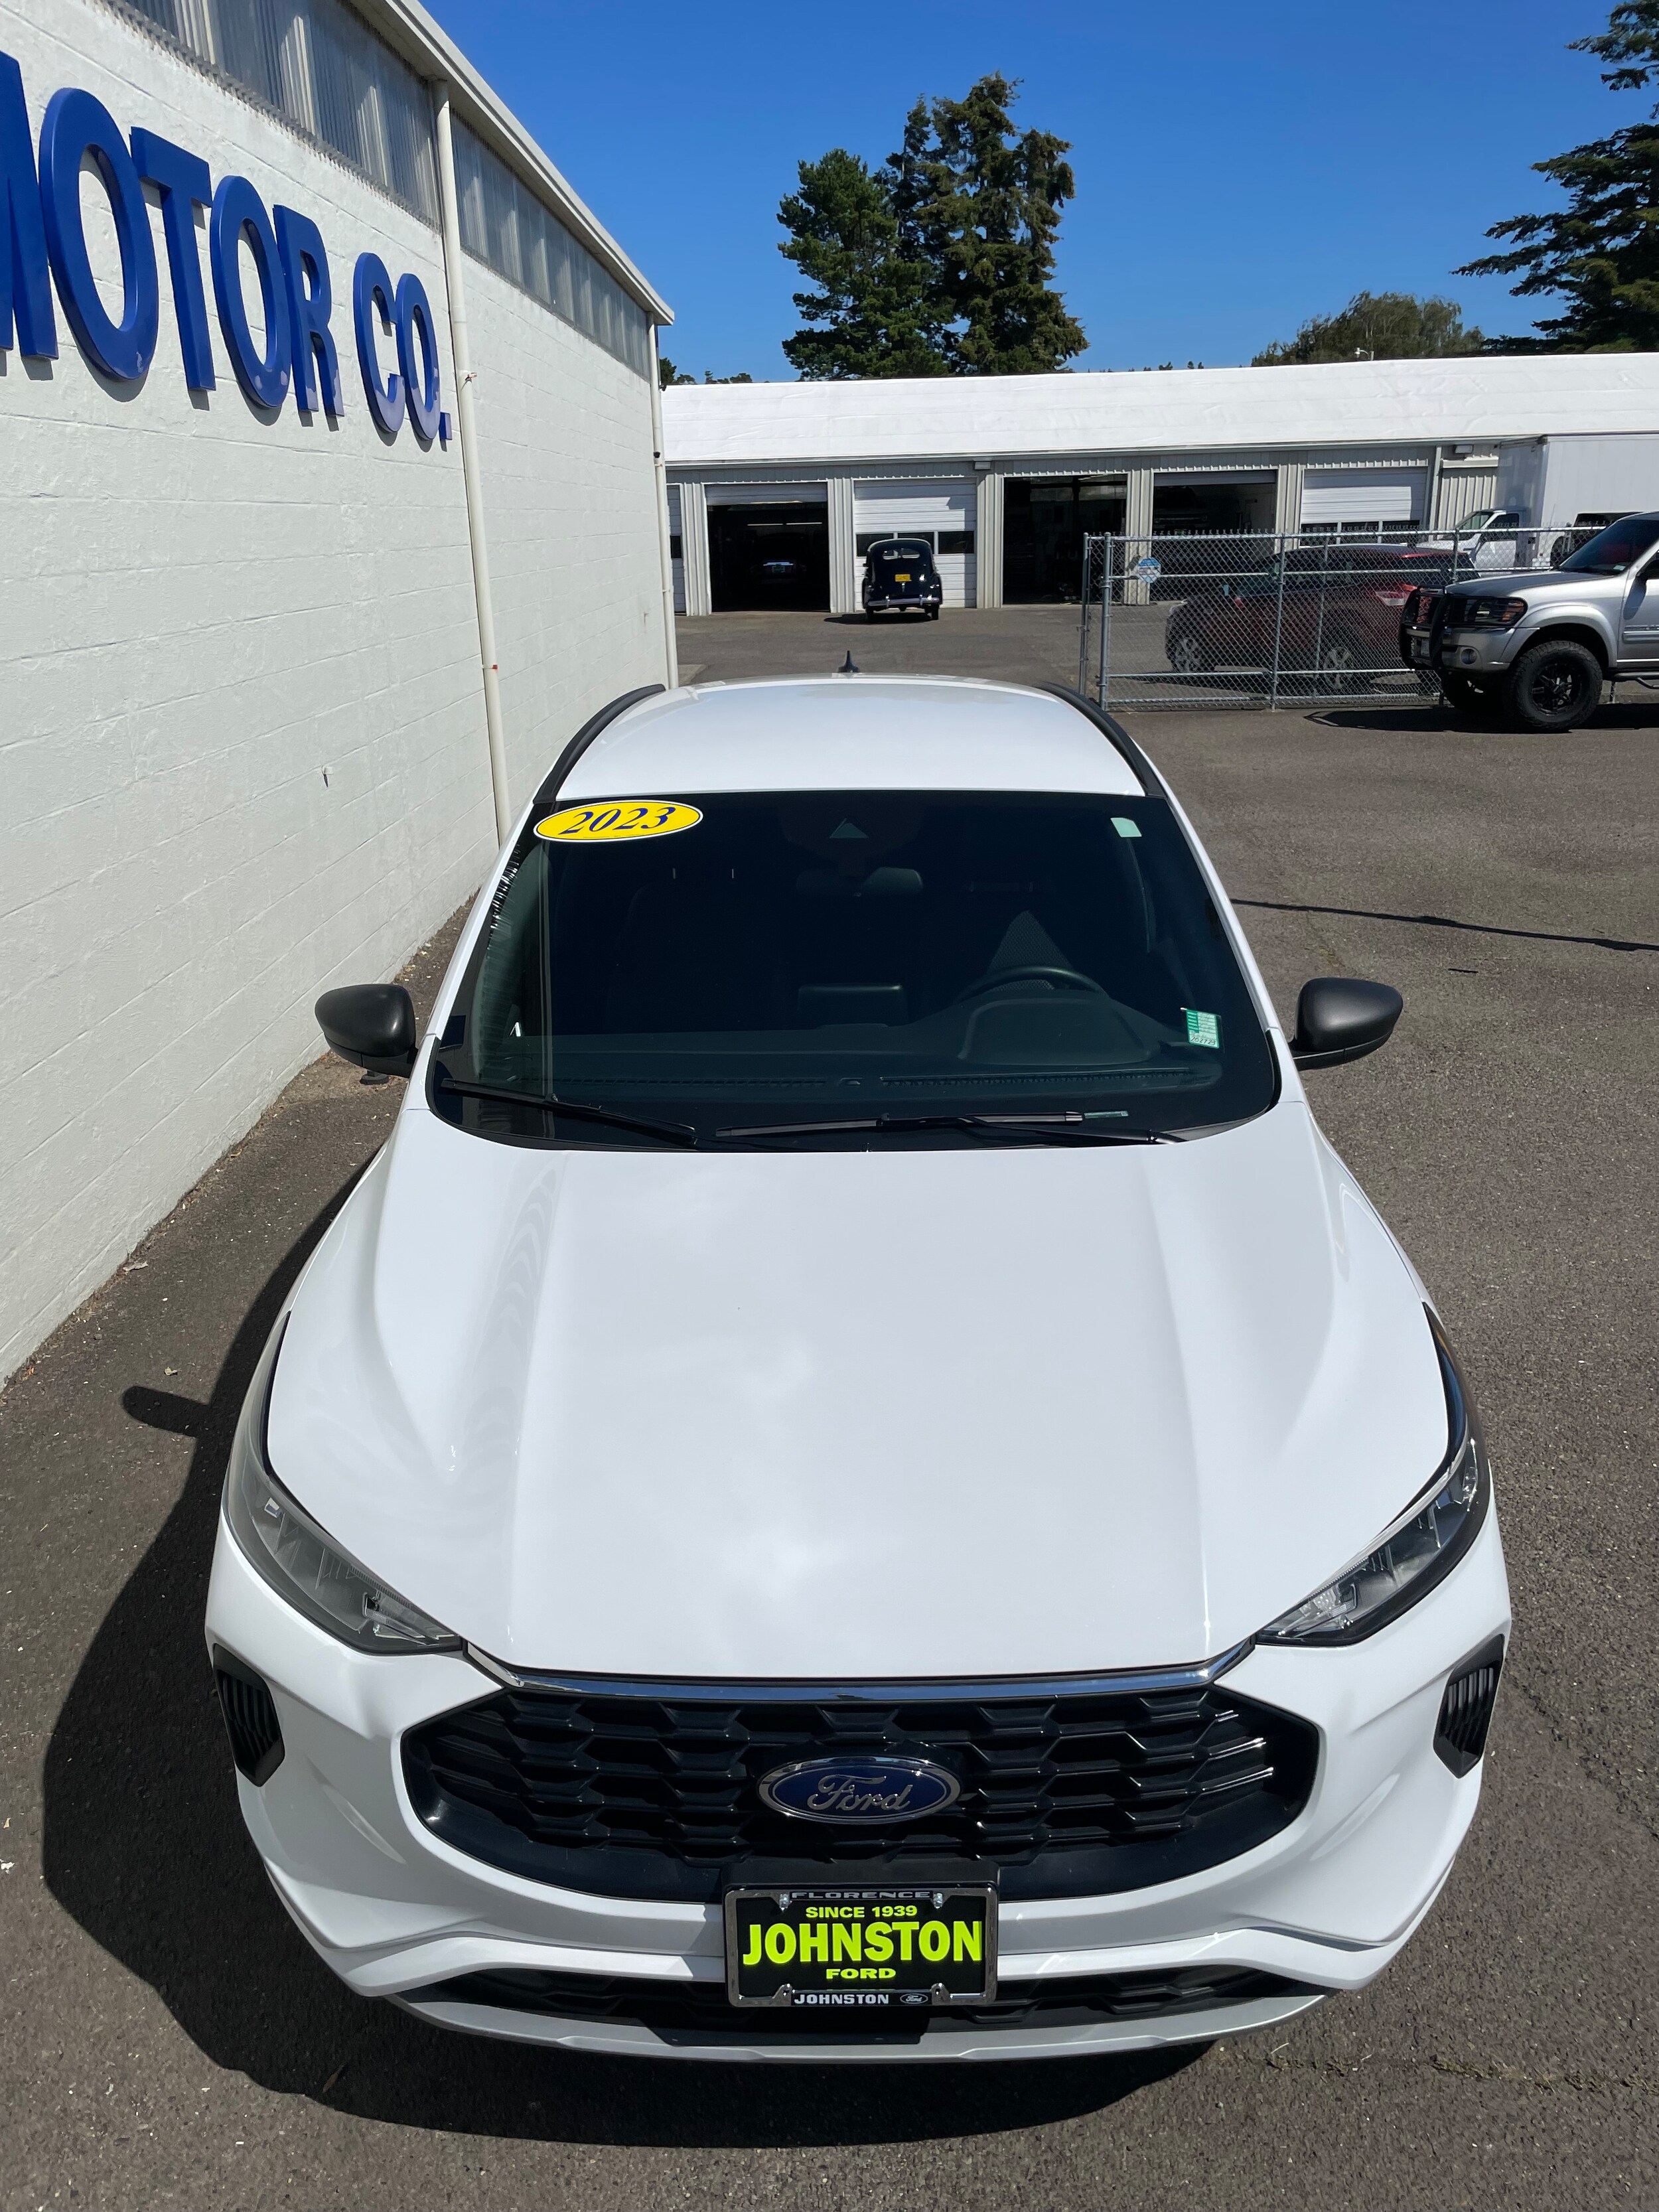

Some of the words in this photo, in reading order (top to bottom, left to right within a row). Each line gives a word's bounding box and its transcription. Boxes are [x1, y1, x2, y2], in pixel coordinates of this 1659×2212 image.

[353, 252, 452, 441] CO.
[558, 807, 676, 835] 2023
[807, 1774, 914, 1811] Ford
[806, 1907, 865, 1918] SINCE
[872, 1905, 918, 1917] 1939
[743, 1921, 983, 1965] JOHNSTON
[826, 1968, 897, 1979] FORD
[794, 1994, 889, 2004] JOHNSTON
